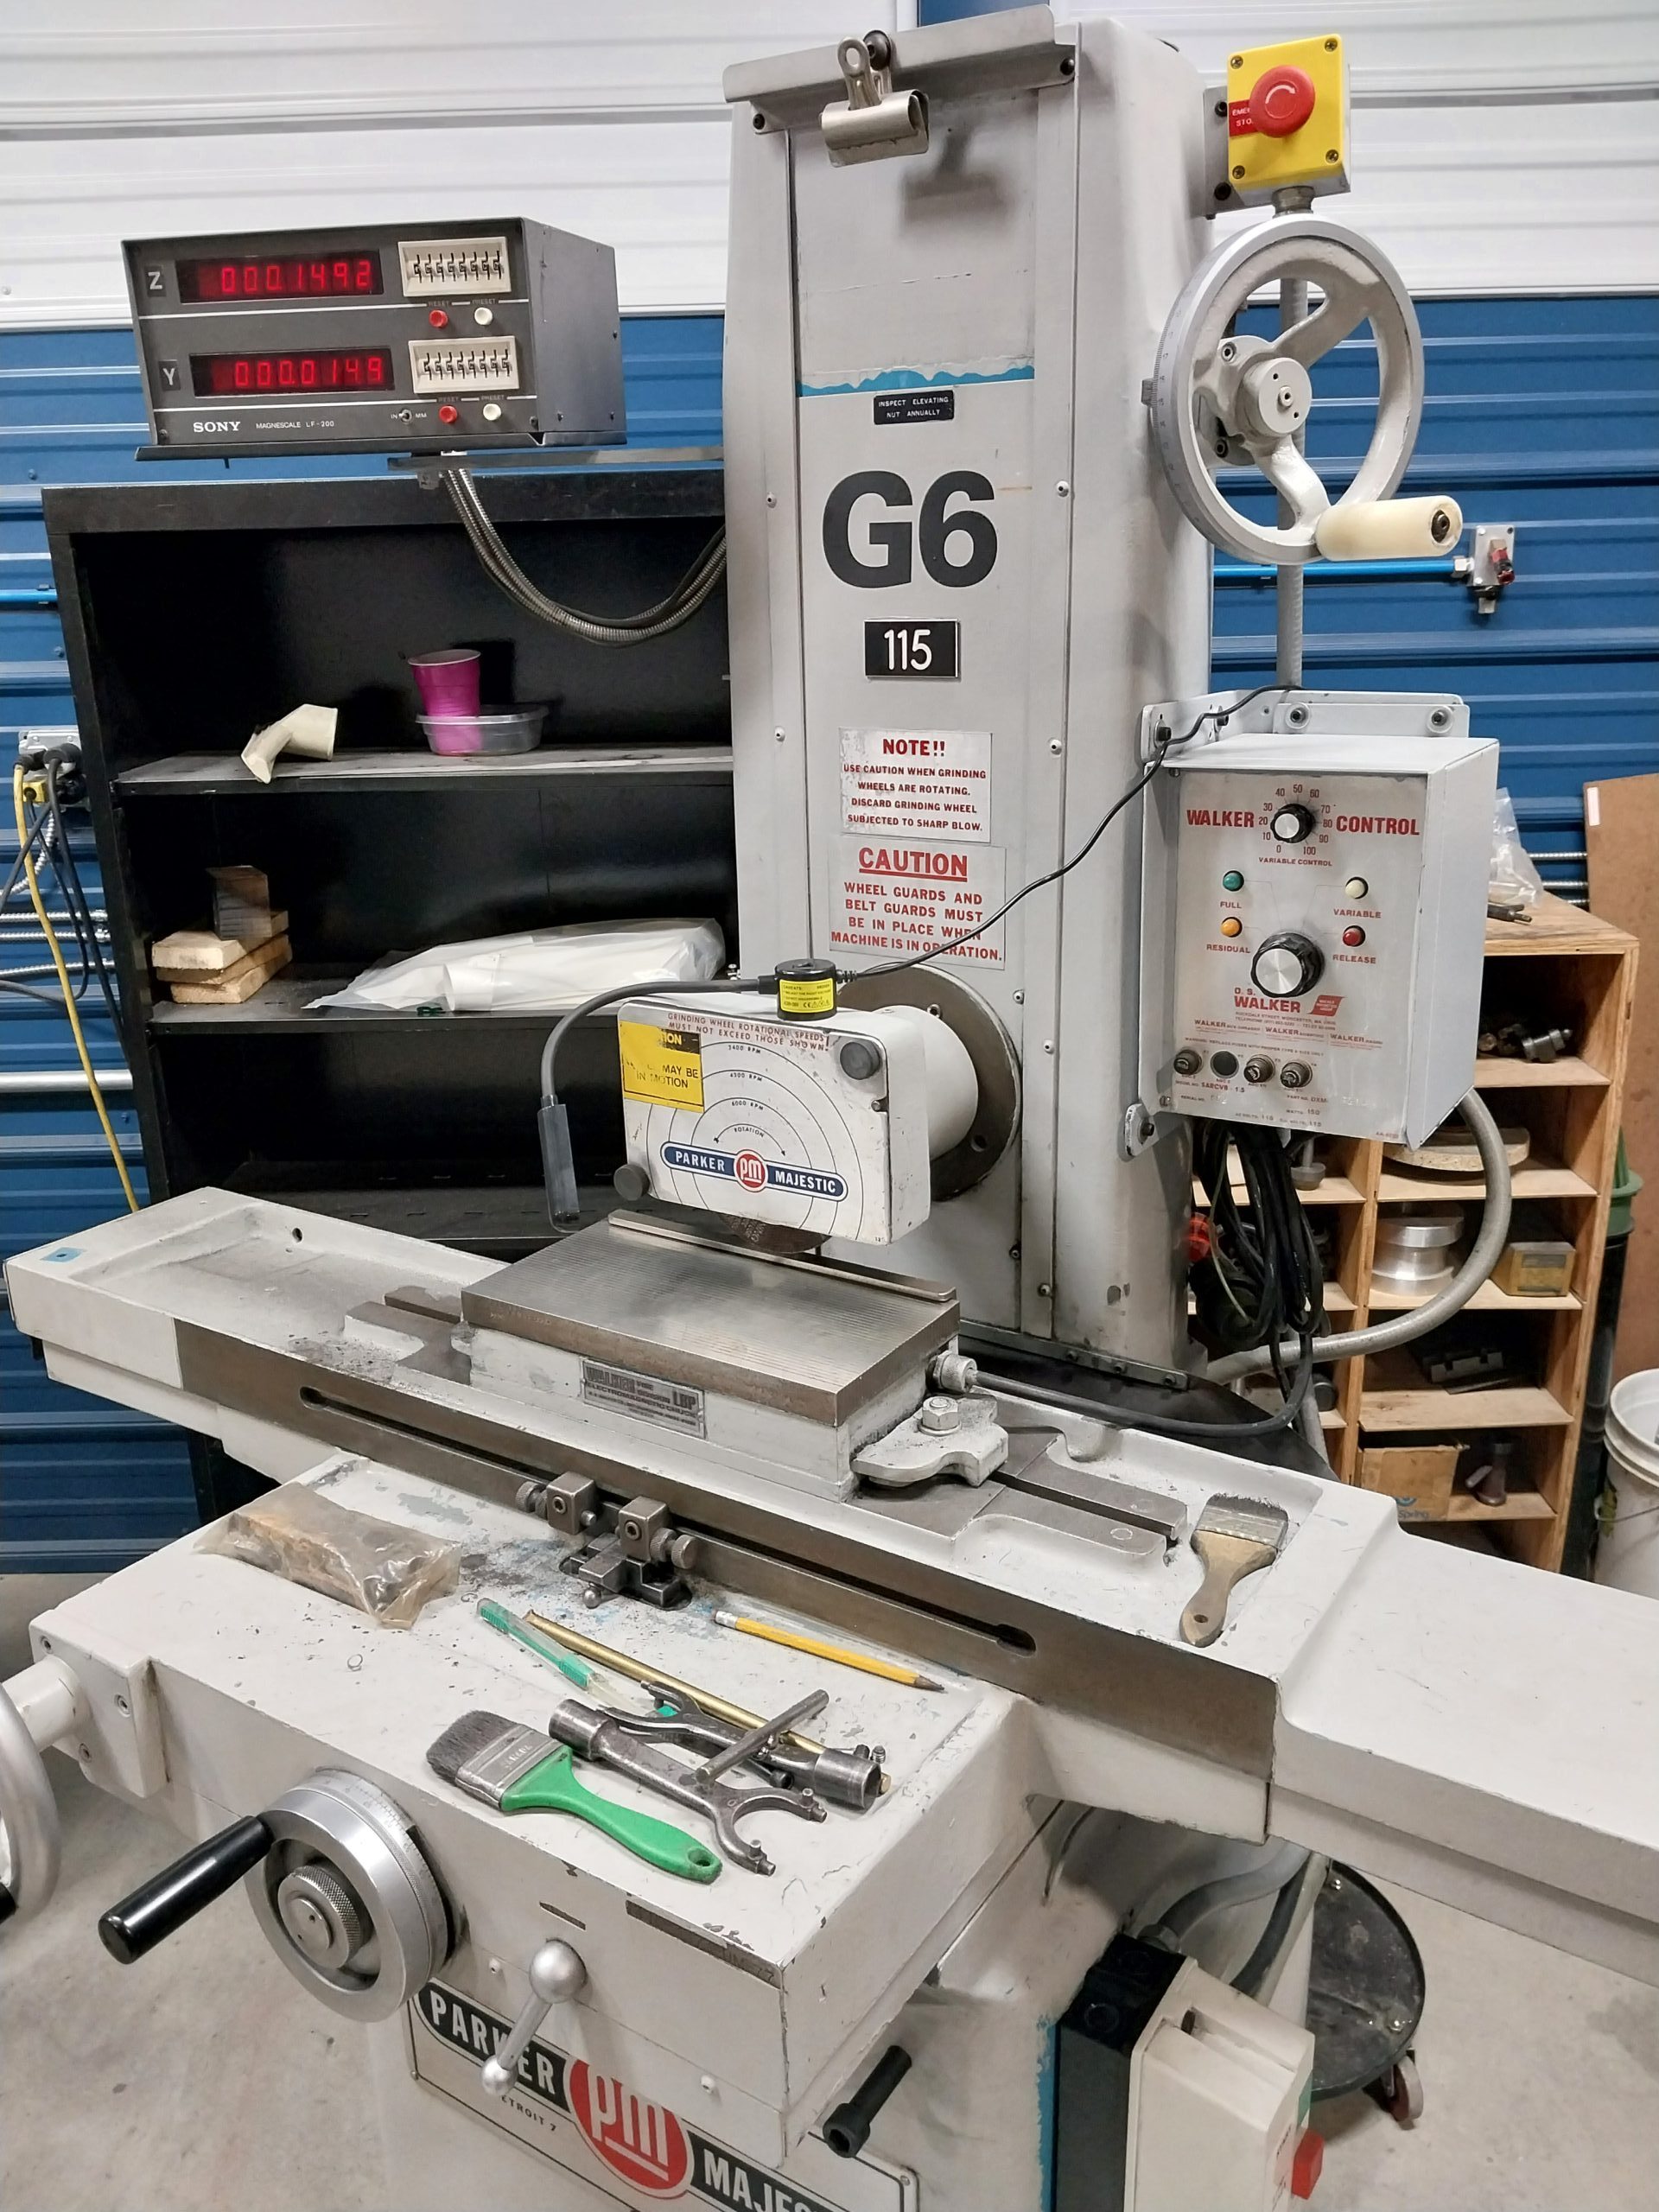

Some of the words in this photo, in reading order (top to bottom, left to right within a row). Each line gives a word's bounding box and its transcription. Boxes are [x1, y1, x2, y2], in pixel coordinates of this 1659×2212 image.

[148, 271, 162, 290] Z
[162, 367, 176, 385] Y
[878, 399, 906, 408] INSPECT
[912, 397, 949, 405] ELEVATING
[907, 409, 940, 417] ANNUALLY
[193, 421, 241, 433] SONY
[256, 421, 302, 429] MAGNESCALE
[822, 470, 998, 588] G6
[884, 629, 932, 671] 115
[843, 764, 861, 772] USE
[863, 765, 905, 775] CAUTION
[907, 767, 936, 777] WHEN
[938, 768, 986, 779] GRINDING
[857, 781, 895, 791] WHEELS
[898, 784, 917, 792] ARE
[919, 785, 970, 796] ROTATING.
[1275, 788, 1285, 798] 40
[1293, 785, 1303, 793] 50
[1309, 789, 1319, 798] 60
[851, 798, 892, 808] DISCARD
[894, 800, 940, 811] GRINDING
[944, 803, 977, 813] WHEEL
[1263, 803, 1273, 811] 30
[1321, 805, 1331, 814] 70
[848, 814, 899, 826] SUBJECTED
[917, 819, 949, 829] SHARP
[951, 821, 982, 831] BLOW.
[1186, 810, 1255, 828] WALKER
[1337, 816, 1420, 836] CONTROL
[1258, 817, 1268, 825] 20
[1323, 819, 1332, 829] 80
[1262, 832, 1271, 841] 10
[1319, 835, 1329, 843] 90
[1303, 846, 1316, 855] 100
[859, 847, 968, 876] CAUTION
[844, 882, 887, 896] WHEEL
[893, 887, 946, 901] GUARDS
[954, 893, 982, 905] AND
[845, 899, 876, 912] BELT
[884, 903, 936, 918] GUARDS
[944, 909, 983, 922] MUST
[1333, 909, 1382, 918] VARIABLE
[849, 917, 865, 928] BE
[872, 918, 885, 931] IN
[893, 921, 934, 936] PLACE
[831, 931, 887, 947] MACHINE
[891, 938, 903, 949] IS
[906, 940, 919, 951] IN
[1206, 944, 1251, 954] RESIDUAL
[1332, 954, 1376, 964] RELEASE
[1234, 995, 1301, 1014] WALKER
[668, 1013, 706, 1025] GRINDING
[709, 1018, 735, 1030] WHEEL
[738, 1022, 790, 1037] ROTATIONAL
[794, 1030, 824, 1042] SPEEDS
[1194, 1019, 1227, 1028] WALKER
[669, 1022, 691, 1032] MUST
[696, 1025, 714, 1034] NOT
[718, 1028, 750, 1041] EXCEED
[755, 1034, 784, 1046] THOSE
[1265, 1026, 1300, 1036] WALKER
[1330, 1033, 1364, 1043] WALKER
[637, 1071, 646, 1080] IN
[663, 1065, 683, 1076] MAY
[686, 1068, 699, 1079] BE
[748, 1073, 762, 1082] RPM
[750, 1102, 764, 1110] RPM
[734, 1127, 765, 1137] ROTATION
[675, 1150, 725, 1172] PARKER
[775, 1170, 836, 1194] MAJESTIC
[499, 2093, 545, 2126] ETROIT
